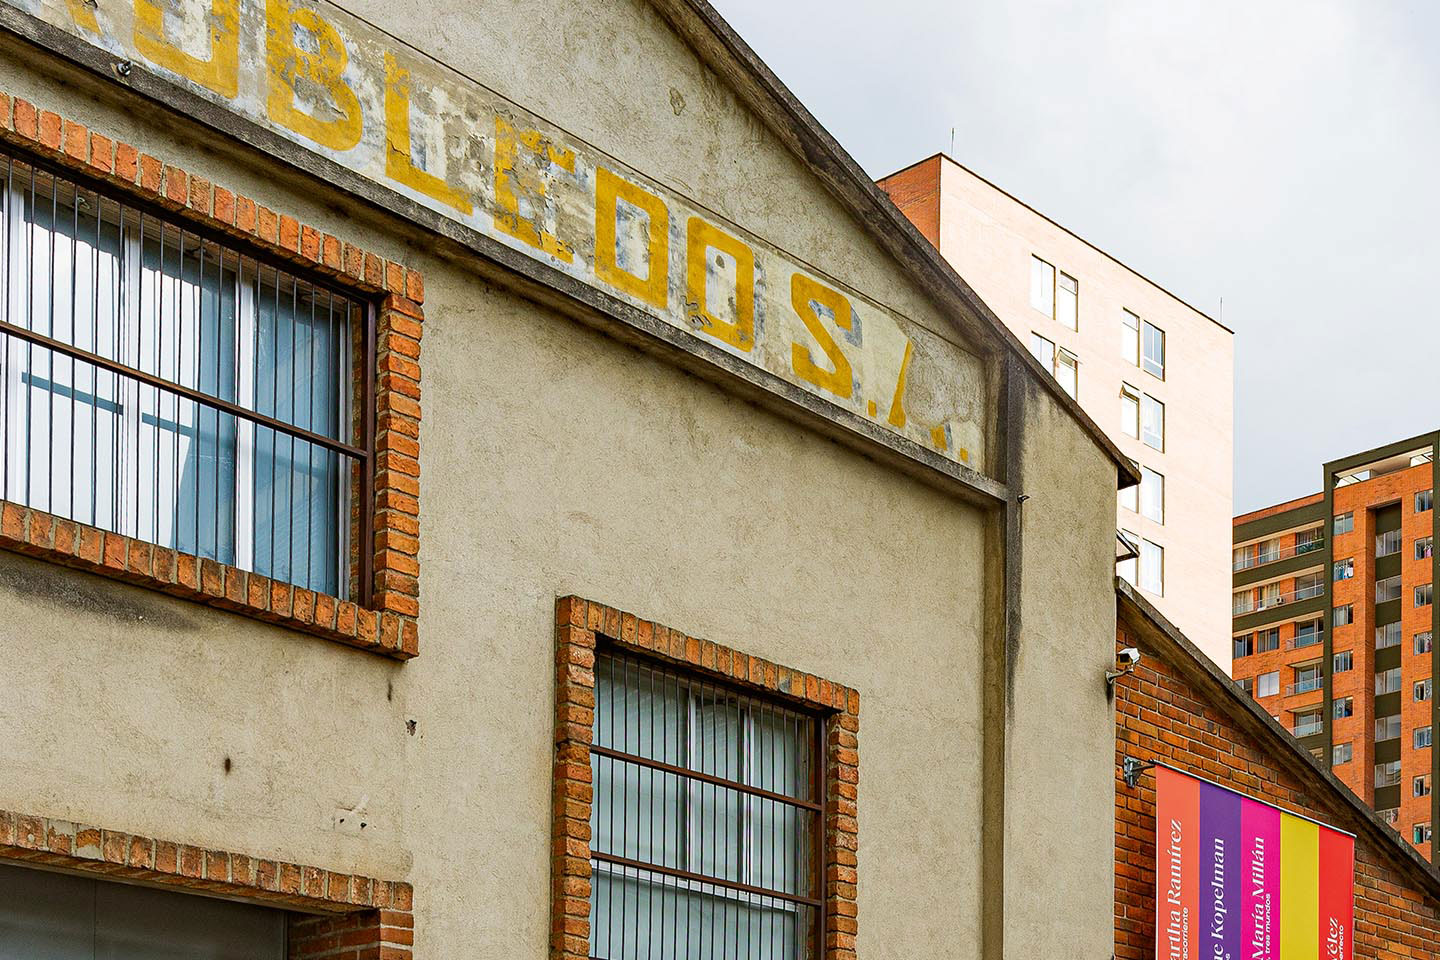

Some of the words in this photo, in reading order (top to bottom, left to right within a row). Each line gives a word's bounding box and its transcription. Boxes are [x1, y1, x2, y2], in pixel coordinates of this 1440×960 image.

[66, 0, 757, 351] OBLEDO
[1166, 819, 1182, 906] Ramírez
[1210, 838, 1227, 939] Kopelman
[1251, 836, 1265, 900] Millán
